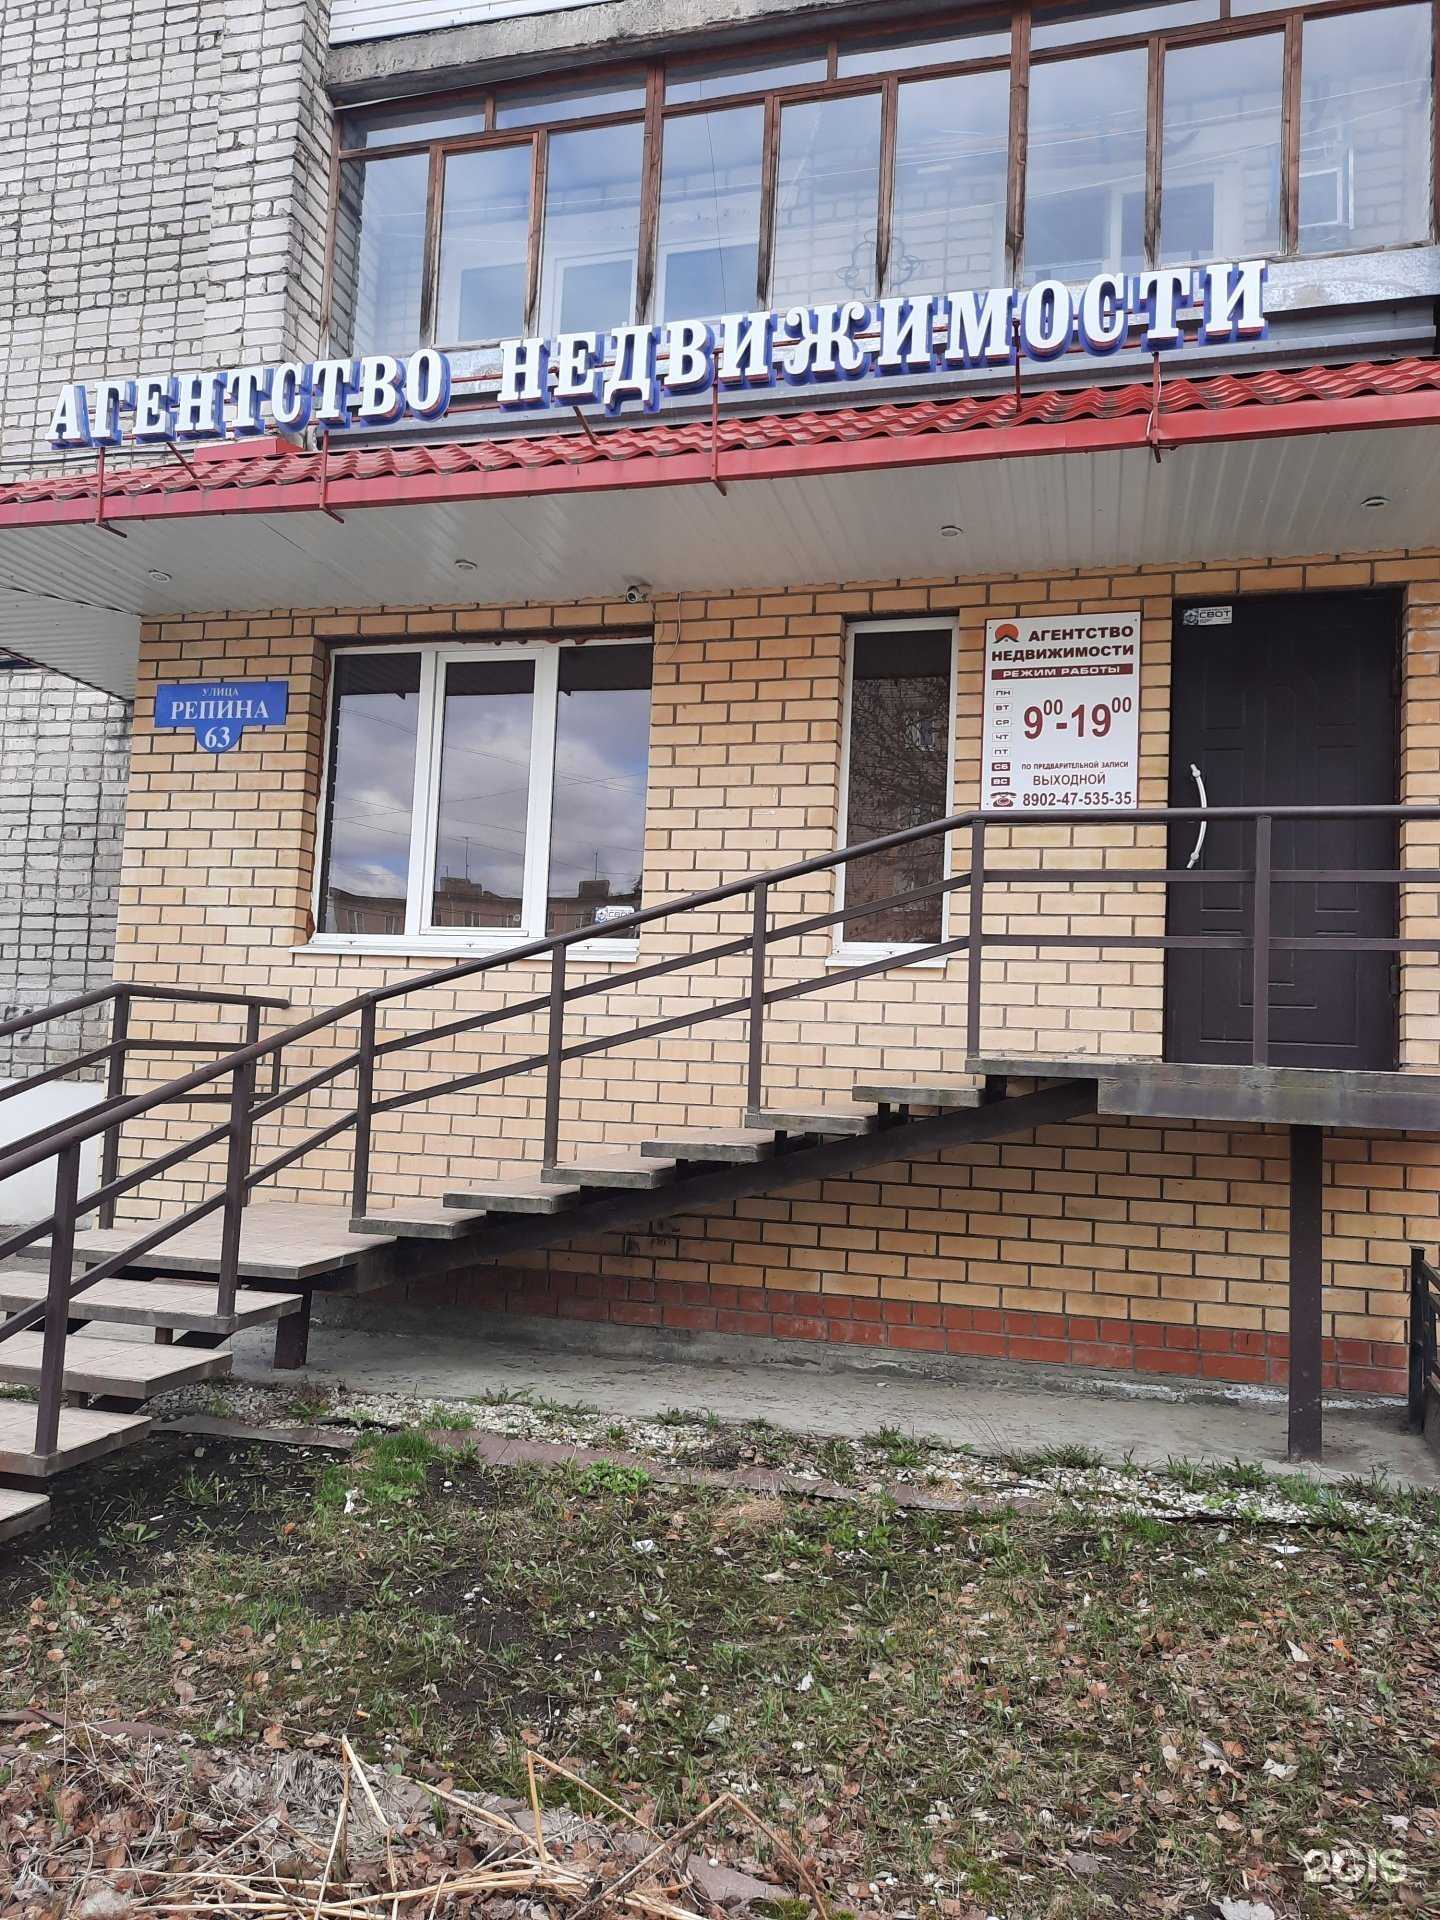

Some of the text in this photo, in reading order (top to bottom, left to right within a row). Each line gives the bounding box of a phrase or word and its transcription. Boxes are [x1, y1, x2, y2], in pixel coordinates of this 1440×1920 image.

[46, 260, 1267, 448] АГЕНТСТВО НЕДВИЖИМОСТИ
[1028, 626, 1134, 642] АГЕНТСТВО
[991, 644, 1134, 662] НЕДВИЖИМОСТИ
[1002, 666, 1120, 678] РЕЖИМ РАБОТЫ
[201, 687, 239, 698] УЛИЦА
[170, 700, 269, 720] РЕПИНА
[204, 726, 230, 748] 63
[1033, 761, 1099, 770] ПРЕДВАРИТЕЛЬНОЙ
[1100, 761, 1129, 769] ЗАПИСИ
[1033, 771, 1106, 786] ВЫХОДНОЙ
[1022, 791, 1132, 806] 8902-47-535-35
